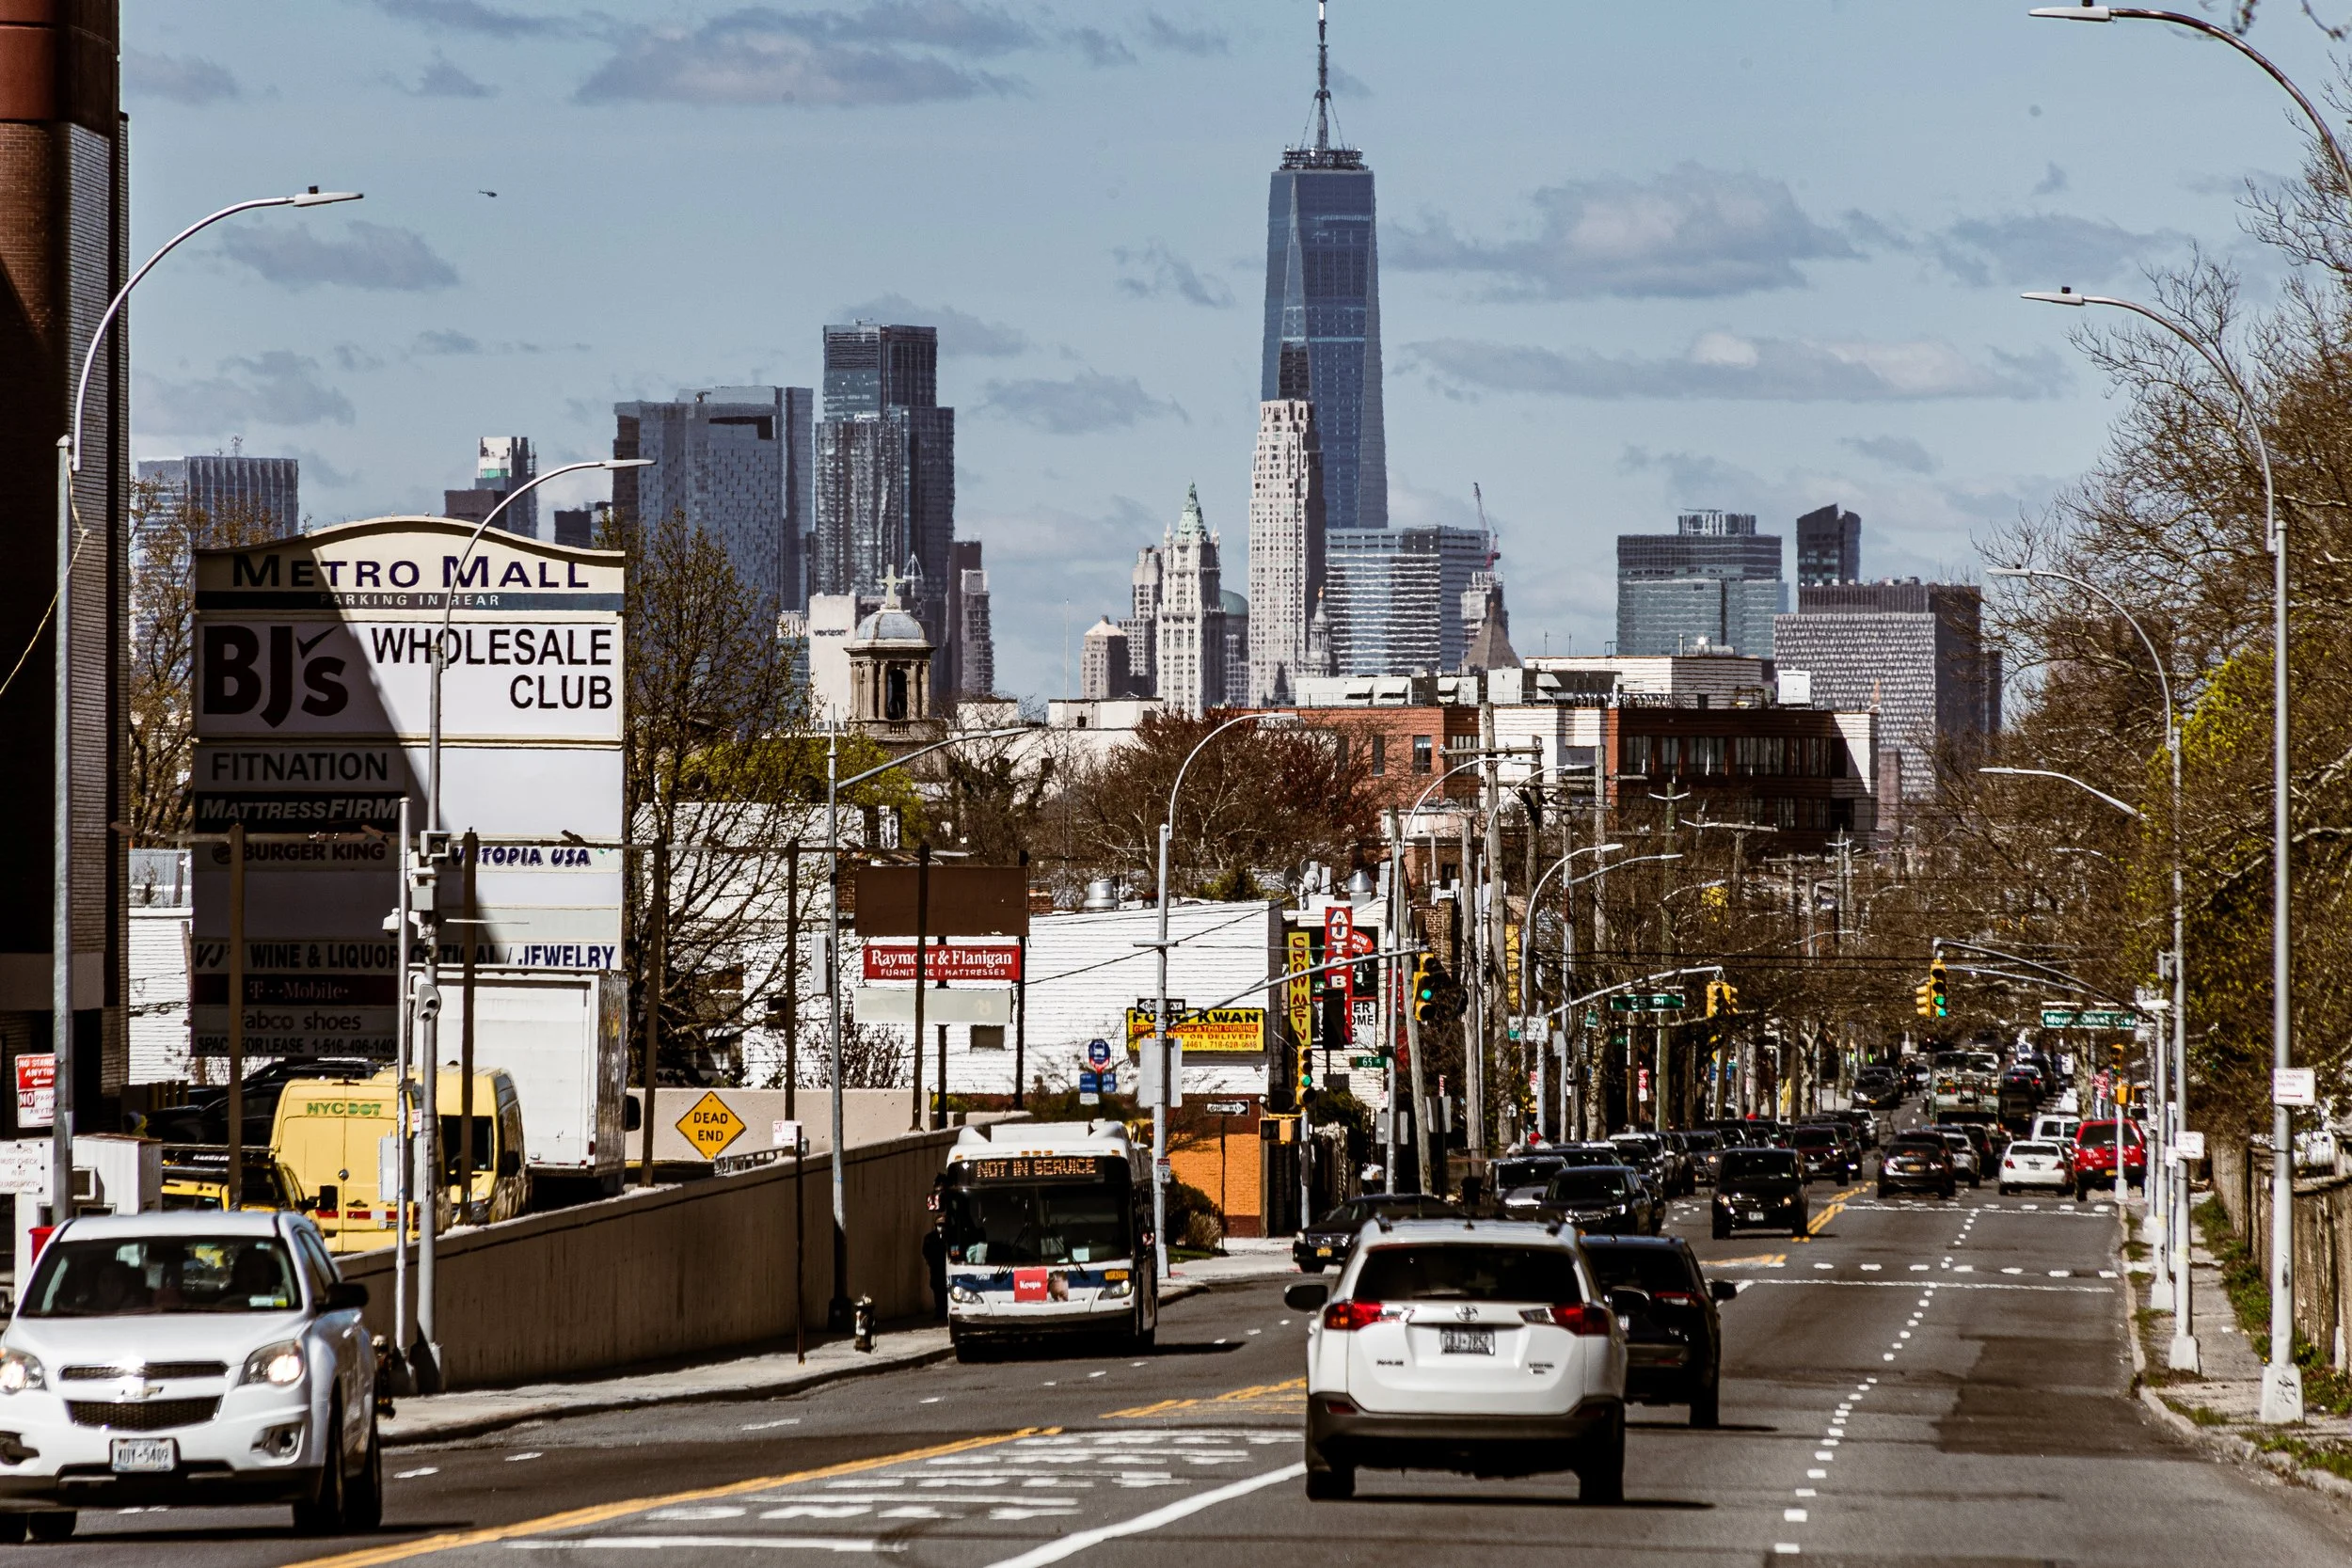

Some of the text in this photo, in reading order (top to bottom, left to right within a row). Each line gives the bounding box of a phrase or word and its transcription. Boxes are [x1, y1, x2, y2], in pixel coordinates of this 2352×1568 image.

[232, 554, 589, 588] METRO MALL
[320, 593, 500, 606] PARKING IN REAR
[813, 627, 847, 637] verizon
[371, 626, 612, 666] WHOLESALE
[509, 674, 612, 710] CLUB
[212, 752, 388, 782] FITNATION
[243, 843, 387, 862] BURGER KING
[550, 847, 592, 867] USA
[250, 944, 300, 968] WINE
[308, 944, 321, 968] &
[938, 950, 949, 965] &
[952, 950, 1012, 968] Flanigan
[881, 968, 935, 976] FURNITRE
[1292, 937, 1309, 1040] CHOW MEIN
[1630, 995, 1646, 1008] 65
[304, 1011, 362, 1031] shoes
[1198, 1011, 1259, 1023] KWAN
[197, 1037, 230, 1053] SPAC
[265, 1037, 303, 1053] LEASE
[19, 1058, 29, 1069] NO
[1362, 1057, 1373, 1068] 65
[19, 1092, 34, 1106] NO
[307, 1102, 382, 1116] NYC DOT
[693, 1112, 728, 1125] DEAD
[697, 1130, 723, 1142] END
[977, 1158, 1097, 1178] NOT IN SERVICE
[1019, 1279, 1041, 1290] Keeps
